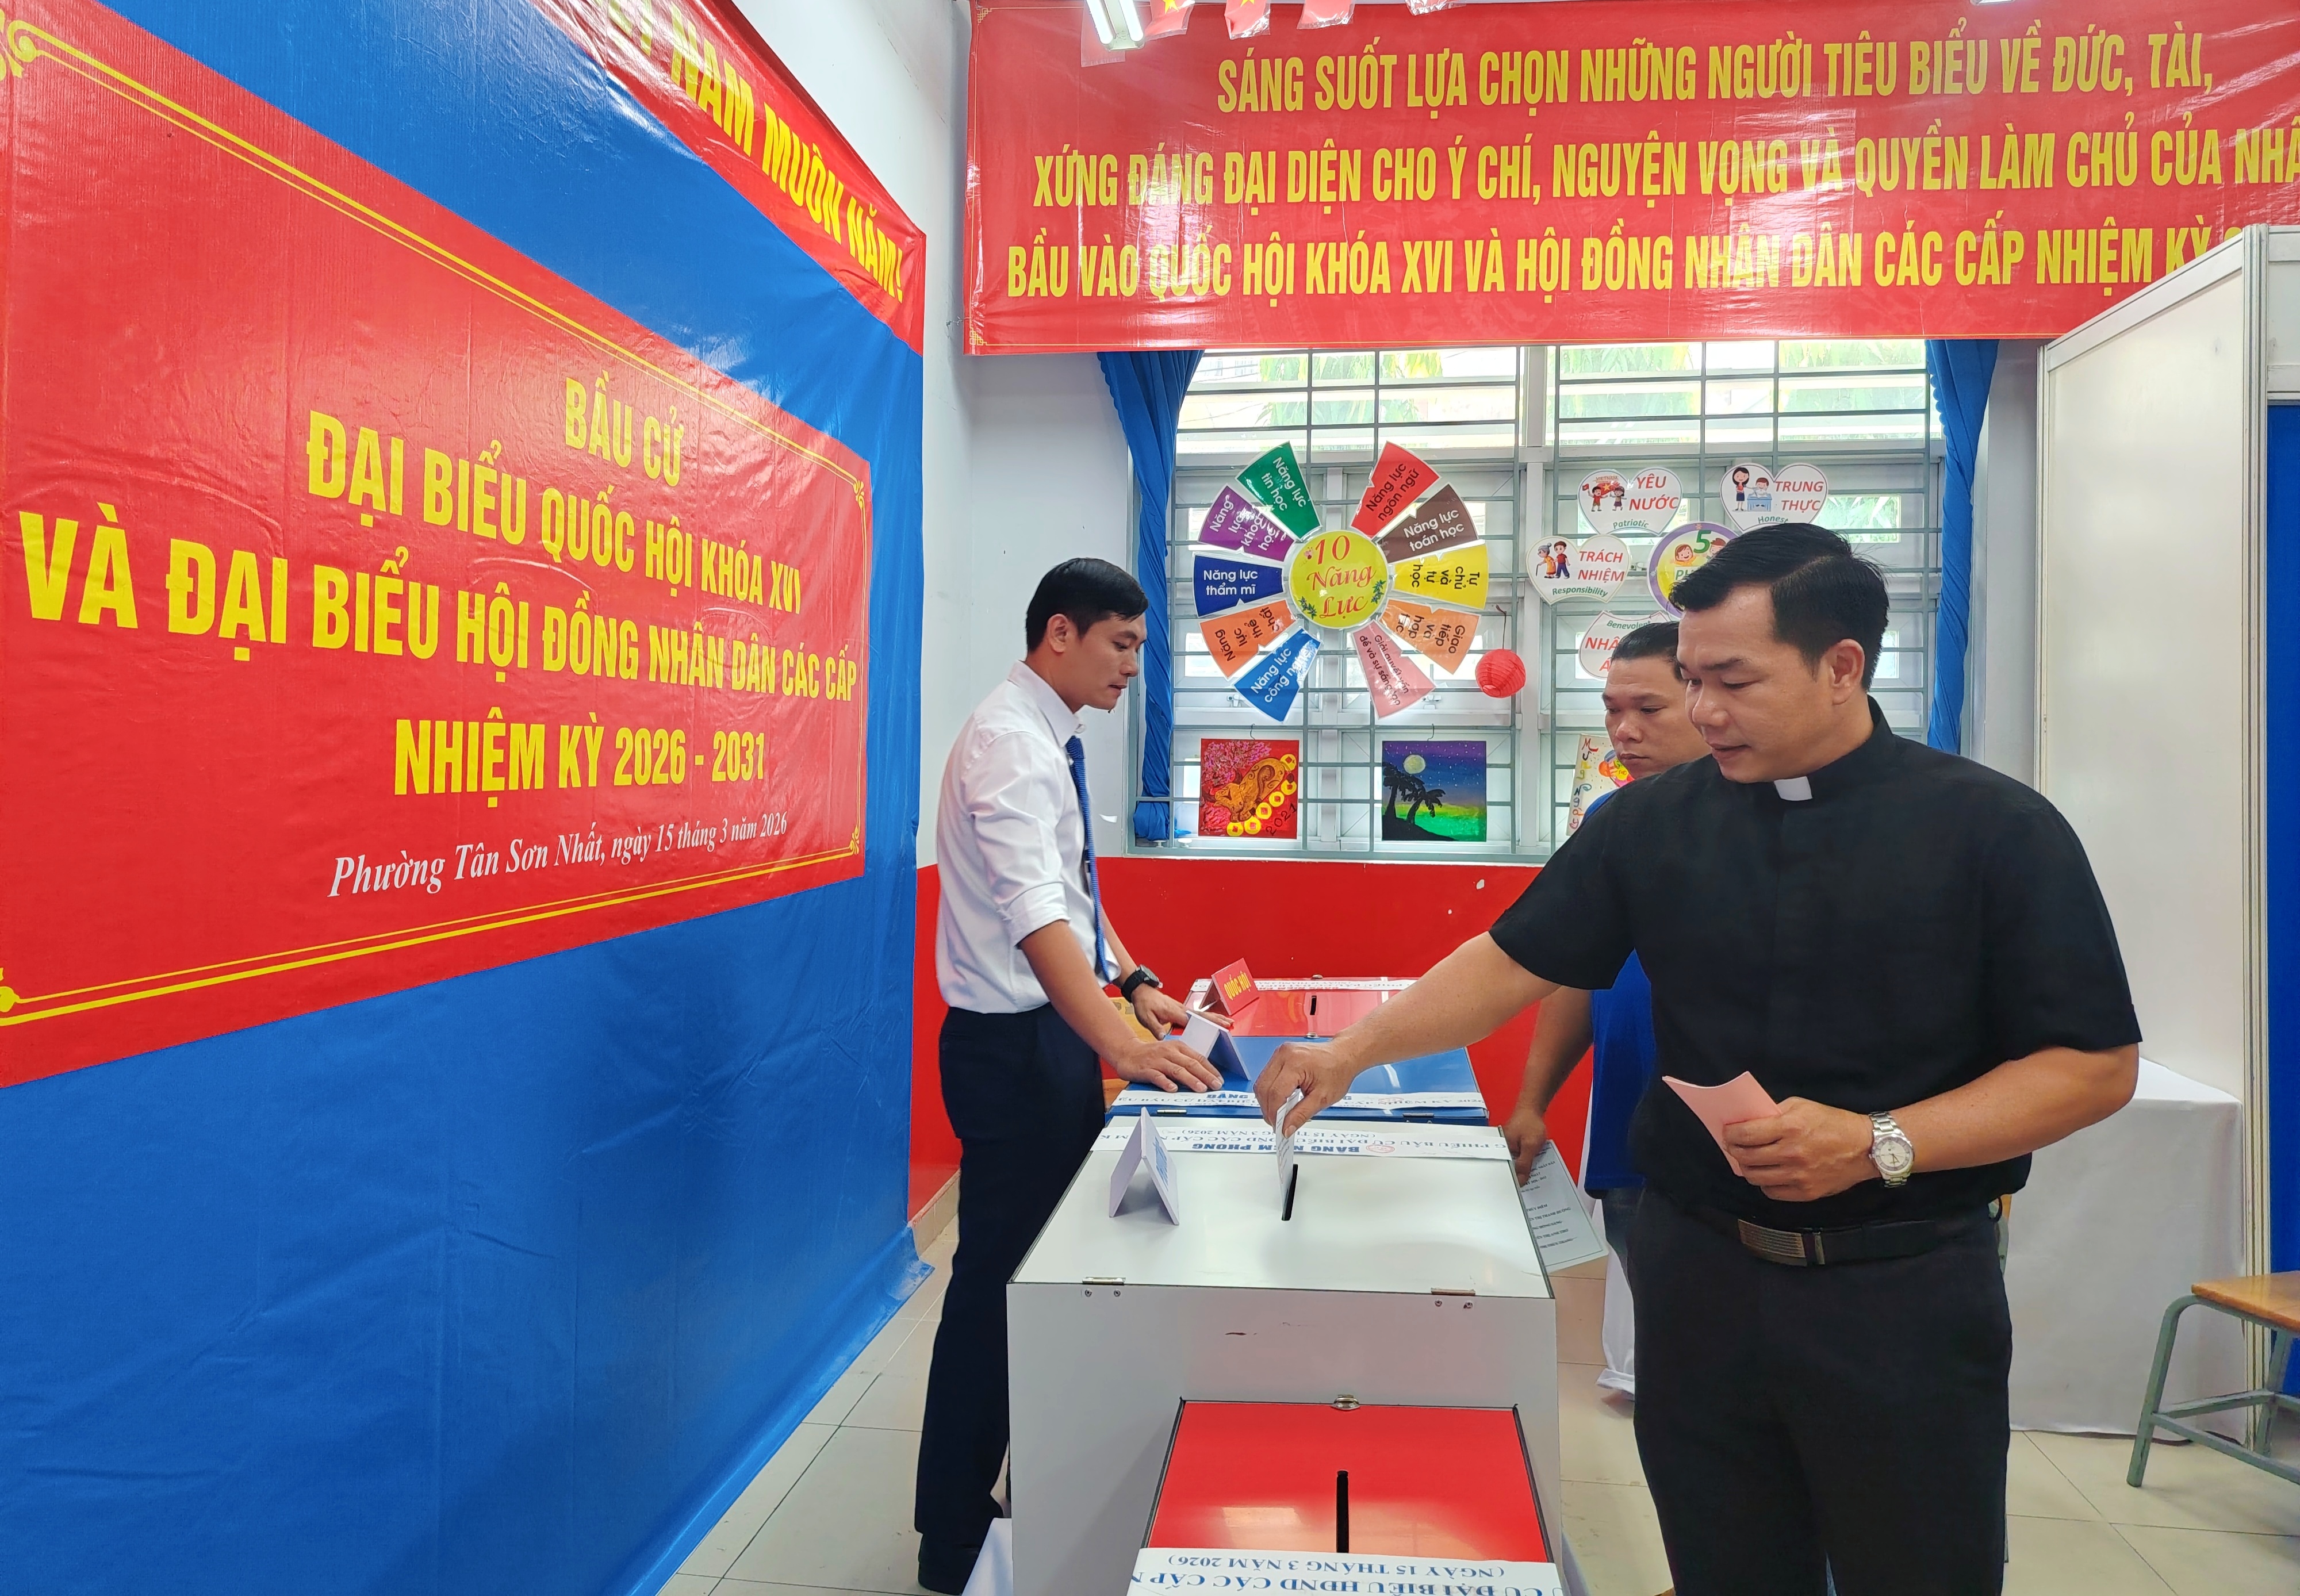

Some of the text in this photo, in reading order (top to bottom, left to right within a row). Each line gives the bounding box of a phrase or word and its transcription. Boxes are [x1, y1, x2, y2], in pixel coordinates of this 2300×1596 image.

[1217, 17, 2212, 118] SÁNG SUỐT LỰA CHỌN NHỮNG NGƯỜI TIÊU BIỂU VỀ ĐỨC, TÀI,
[671, 2, 903, 304] NAM MUÔN NĂM!
[1033, 144, 1118, 208] XỨNG
[1128, 143, 1213, 206] ĐÁNG
[1224, 151, 1276, 216] ĐẠI
[1287, 138, 1361, 214] DIỆN
[1372, 147, 1436, 202] CHO
[1448, 135, 1467, 200] Ý
[1477, 133, 1541, 206] CHÍ,
[1552, 131, 1687, 208] NGUYỆN
[1698, 139, 1787, 206] VỌNG
[1800, 128, 1843, 193] VÀ
[1855, 118, 1968, 198] QUYỀN
[1979, 123, 2056, 190] LÀM
[2067, 112, 2138, 188] CHỦ
[2151, 112, 2222, 186] CỦA
[1007, 227, 1070, 298] BẦU
[1080, 234, 1137, 297] VÀO
[1149, 225, 1232, 302] QUỐC
[1243, 232, 1295, 308] HỘI
[1305, 230, 1391, 295] KHÓA
[1401, 240, 1453, 294] XVI
[1465, 228, 1505, 293] VÀ
[1516, 226, 1571, 304] HỘI
[1581, 217, 1673, 291] ĐỒNG
[1685, 222, 1780, 289] NHÂN
[1791, 221, 1862, 288] DÂN
[1874, 220, 1943, 287] CÁC
[1955, 210, 2025, 286] CẤP
[2037, 216, 2153, 297] NHIỆM
[565, 370, 684, 487] BẦU CỬ
[1261, 472, 1288, 511] tin học
[1273, 456, 1306, 508] Năng lực
[1366, 463, 1407, 512] Năng lực
[1637, 473, 1666, 489] YÊU
[1775, 481, 1824, 492] TRUNG
[1378, 468, 1420, 521] ngôn ngữ
[1629, 494, 1679, 511] NƯỚC
[1781, 500, 1821, 513] THỰC
[307, 409, 800, 615] ĐẠI BIỂU QUỐC HỘI KHÓA XVI
[1209, 500, 1234, 532] Năng
[1404, 509, 1459, 538] Năng lực
[1613, 519, 1649, 529] Patriotic
[1241, 515, 1265, 546] khoa
[1409, 524, 1465, 551] toán học
[1693, 530, 1712, 554] 5
[1315, 535, 1350, 565] 10
[1580, 550, 1623, 563] TRÁCH
[1203, 569, 1258, 581] Năng lực
[1306, 566, 1377, 590] Năng
[1410, 565, 1423, 588] học
[1424, 571, 1437, 583] tự
[1440, 569, 1452, 585] và
[1454, 566, 1466, 589] chủ
[1467, 572, 1479, 586] Tự
[1578, 568, 1625, 583] NHIỆM
[18, 502, 857, 702] VÀ ĐẠI BIỂU HỘI ĐỒNG NHÂN DÂN CÁC CẤP
[1206, 583, 1256, 596] thẩm mĩ
[1552, 586, 1608, 597] Responsibility
[1320, 596, 1368, 619] Lực
[1234, 628, 1248, 647] lực
[1244, 619, 1263, 639] thể
[1424, 624, 1435, 639] và
[1436, 624, 1451, 646] tiếp
[1448, 625, 1465, 654] Giao
[1214, 628, 1236, 661] Năng
[1250, 648, 1291, 694] Năng lực
[1359, 635, 1392, 691] đề và sự sáng
[1264, 676, 1290, 703] công
[394, 707, 765, 808] NHIỆM KỲ 2026 2031
[1266, 803, 1297, 836] 2021
[327, 811, 788, 897] Phường Tân Sơn Nhất, ngày 15 tháng 3 năm 2026
[1224, 974, 1241, 1000] QUỐC
[1237, 970, 1251, 992] HỘI
[1310, 1145, 1360, 1153] BĂNG
[1168, 1554, 1504, 1580] (NGÀY 15 THÁNG 3 NĂM 2026)
[1149, 1572, 1206, 1590] CẤP
[1213, 1575, 1271, 1591] CÁC
[1280, 1578, 1360, 1593] HĐND
